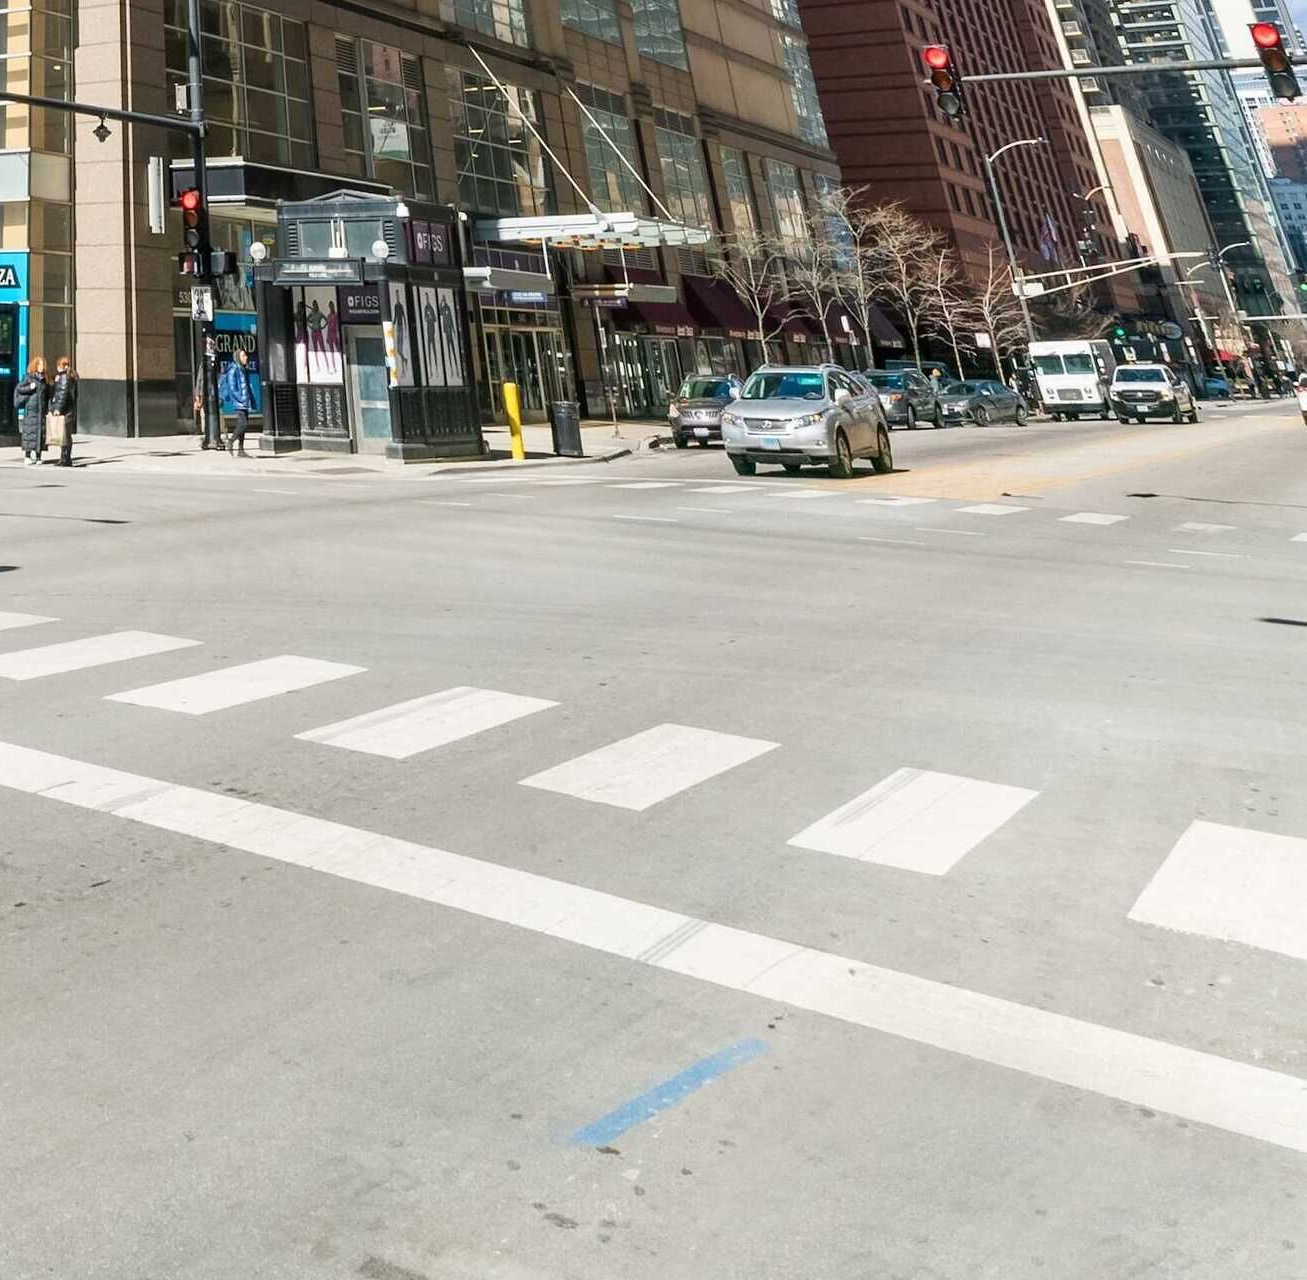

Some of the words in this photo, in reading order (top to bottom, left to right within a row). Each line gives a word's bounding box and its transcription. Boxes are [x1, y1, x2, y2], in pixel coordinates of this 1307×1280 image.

[422, 233, 443, 252] FIGS
[355, 296, 379, 307] FIGS
[215, 334, 256, 352] GRAND
